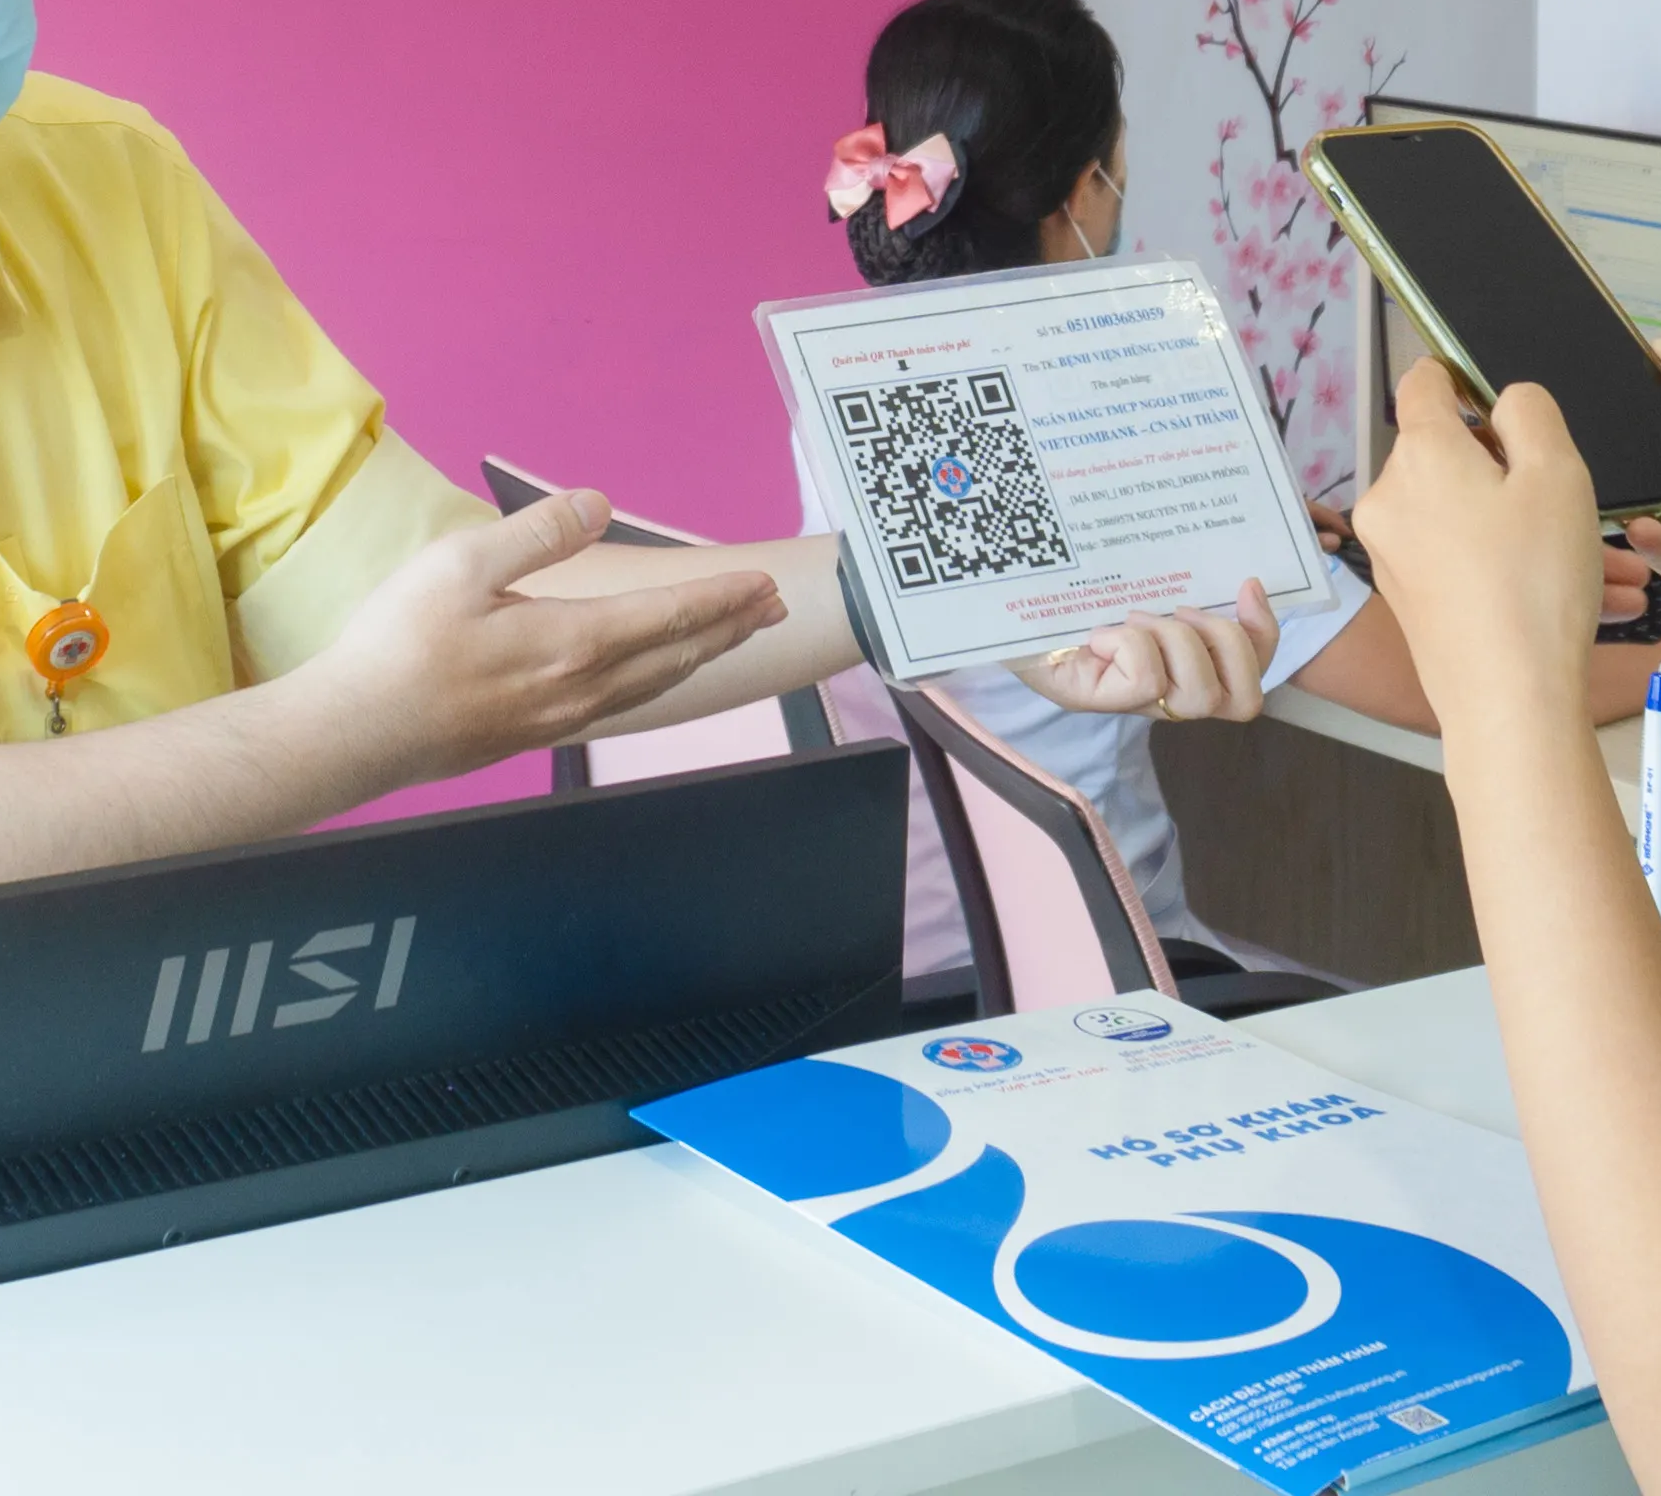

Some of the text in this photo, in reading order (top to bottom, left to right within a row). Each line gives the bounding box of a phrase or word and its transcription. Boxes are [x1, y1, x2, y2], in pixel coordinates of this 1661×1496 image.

[1066, 306, 1165, 333] 0511003683059
[870, 349, 885, 361] QR
[887, 346, 917, 359] Thanh
[1022, 362, 1040, 373] Tên
[1058, 353, 1090, 369] BỆNH
[1093, 348, 1123, 364] VIỆN
[1123, 343, 1157, 357] HÙNG
[1158, 337, 1200, 352] VƯƠNG
[1032, 386, 1230, 429] NGÂN HÀNG TMCP NGOẠI THƯƠNG
[1038, 424, 1138, 452] VIETCOMBANK
[1171, 414, 1194, 430] SÀI
[1194, 408, 1240, 426] THÀNH
[1144, 453, 1156, 465] TT
[141, 915, 417, 1053] MSI
[1088, 1093, 1357, 1160] HỒ SƠ KHÁM
[1146, 1105, 1388, 1168] PHỤ KHOA
[1189, 1394, 1236, 1423] CÁCH
